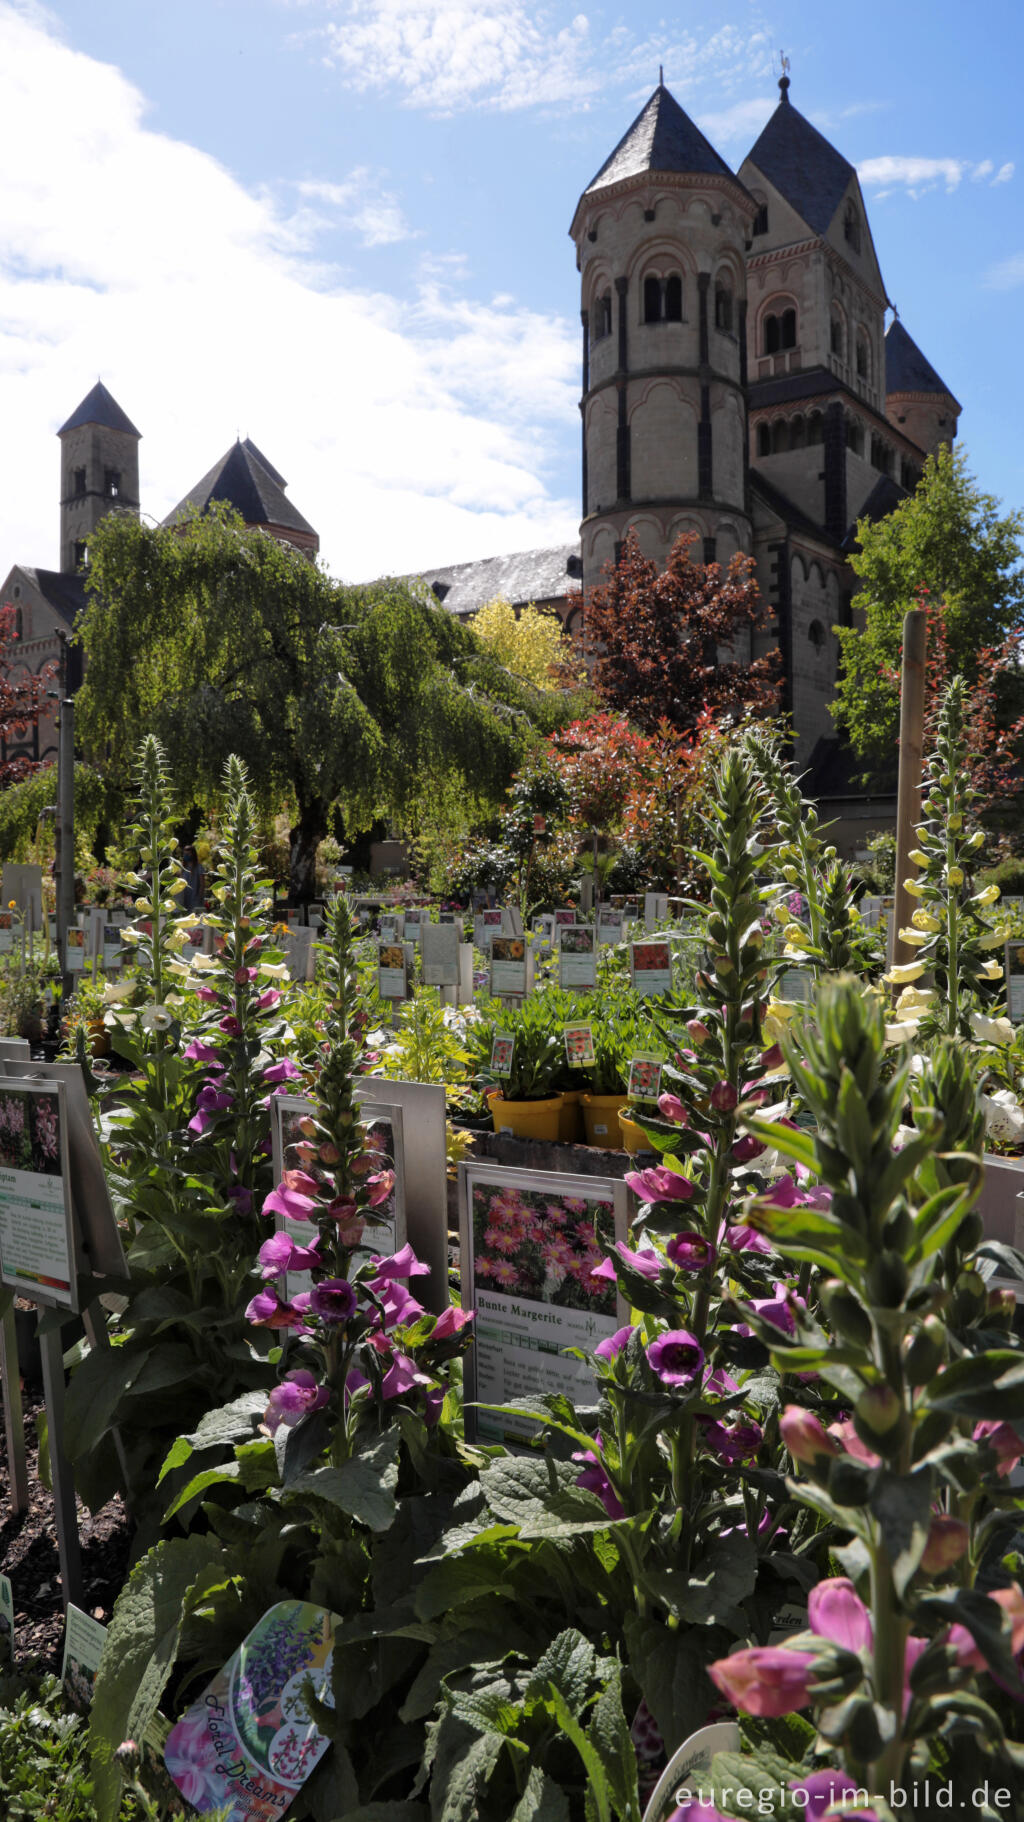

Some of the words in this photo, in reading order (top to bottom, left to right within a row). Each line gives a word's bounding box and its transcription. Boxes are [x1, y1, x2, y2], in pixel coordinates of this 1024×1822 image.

[478, 1296, 507, 1312] Bunte
[511, 1304, 562, 1324] Margerite
[776, 1612, 802, 1625] rden
[204, 1694, 235, 1757] Floral
[215, 1760, 286, 1807] Dreams
